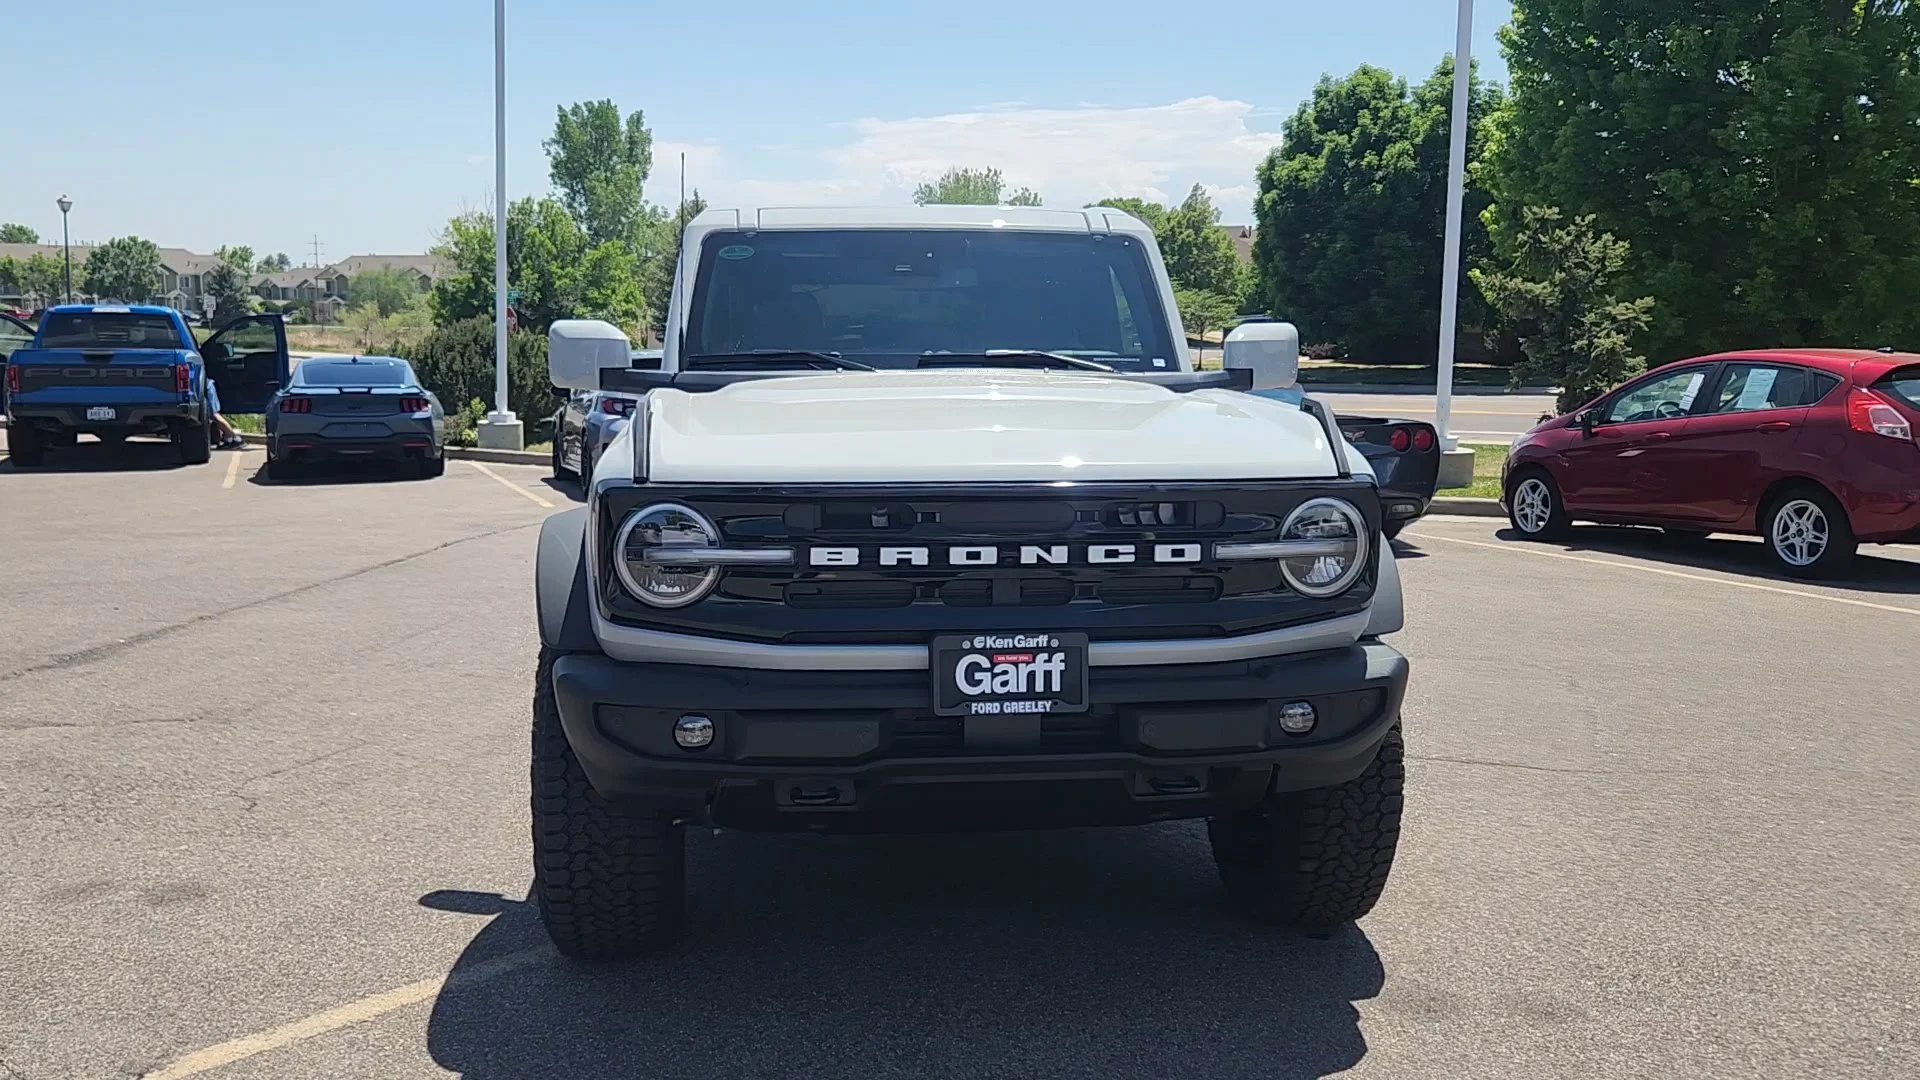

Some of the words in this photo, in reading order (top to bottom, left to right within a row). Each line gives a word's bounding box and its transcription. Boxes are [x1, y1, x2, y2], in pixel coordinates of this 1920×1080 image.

[24, 368, 171, 378] FORD
[809, 544, 1201, 566] BRONCO
[986, 636, 1013, 649] Ken
[1014, 635, 1049, 648] Garff
[955, 652, 1066, 696] Garff
[971, 702, 1000, 715] FORD
[1003, 700, 1052, 714] GREELEY
